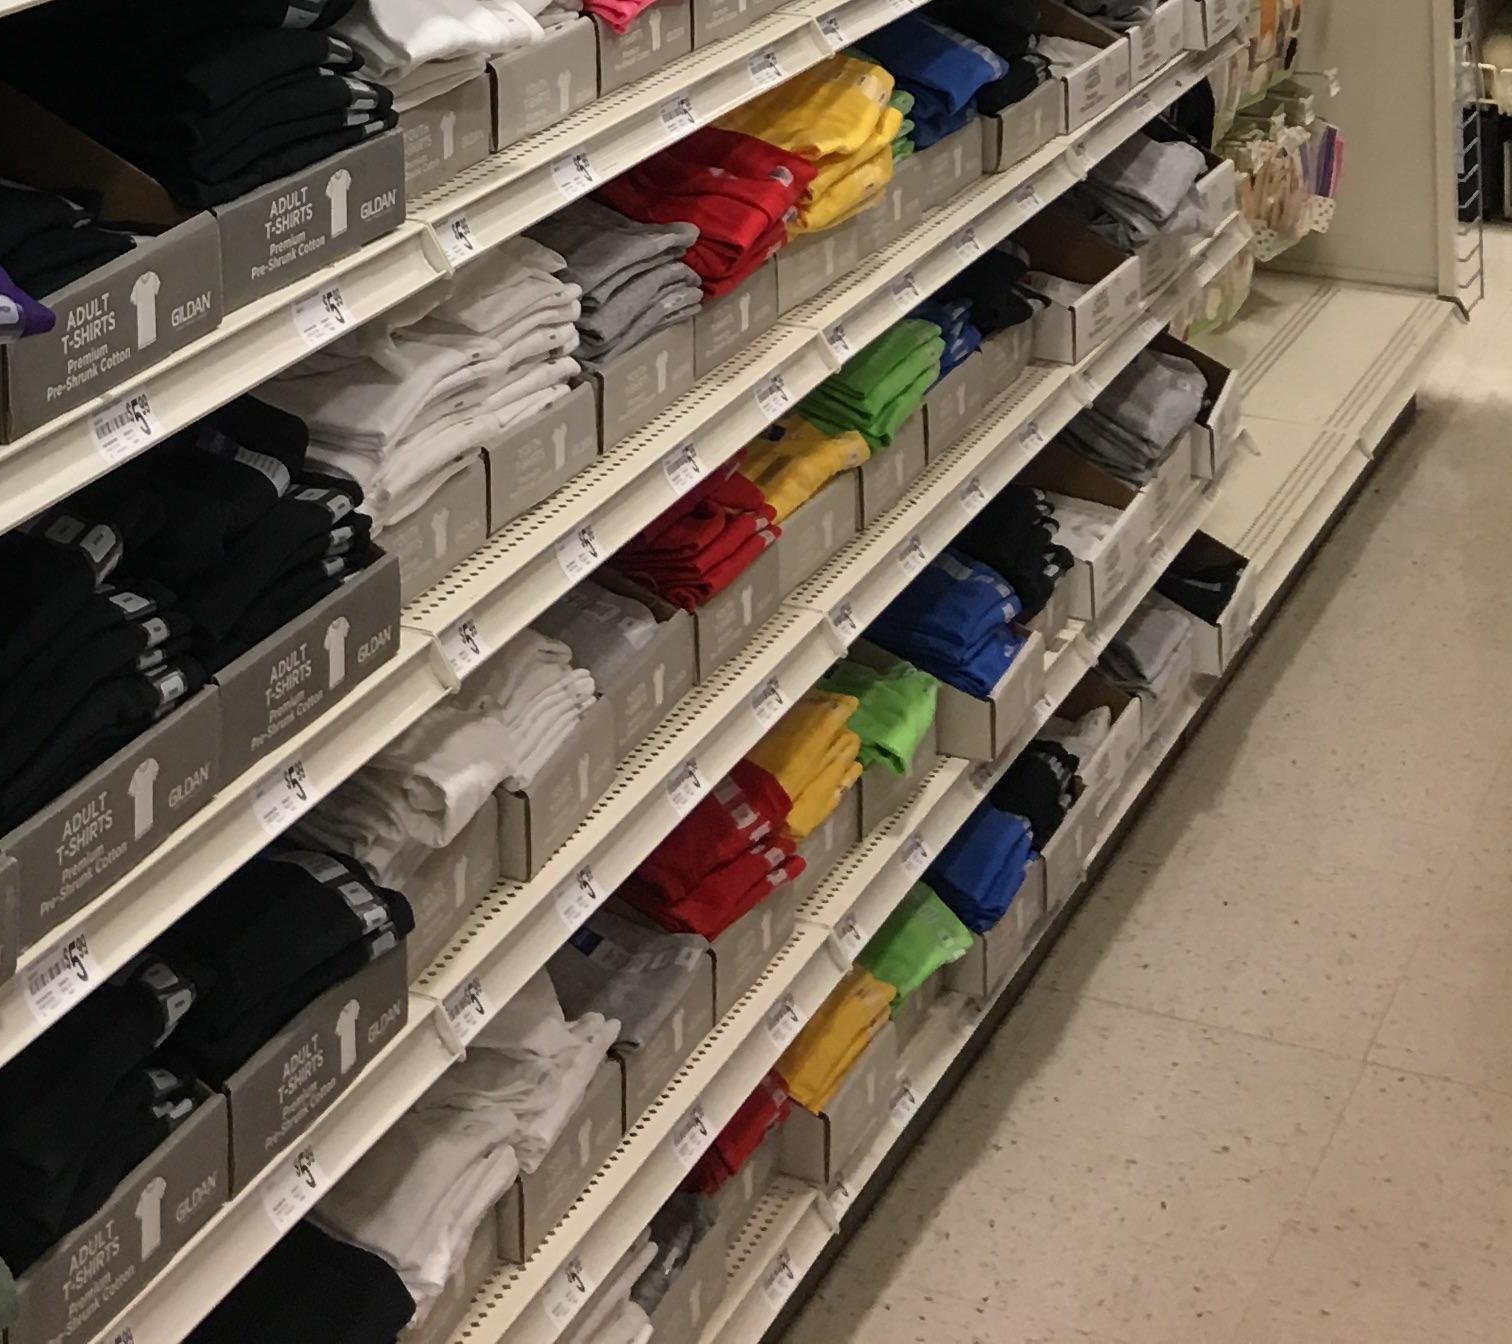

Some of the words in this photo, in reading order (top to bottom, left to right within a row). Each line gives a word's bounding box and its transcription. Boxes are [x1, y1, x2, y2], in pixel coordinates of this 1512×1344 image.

[269, 186, 309, 219] ADULT
[359, 188, 398, 221] GILDAN
[263, 203, 314, 242] T-SHIRTS
